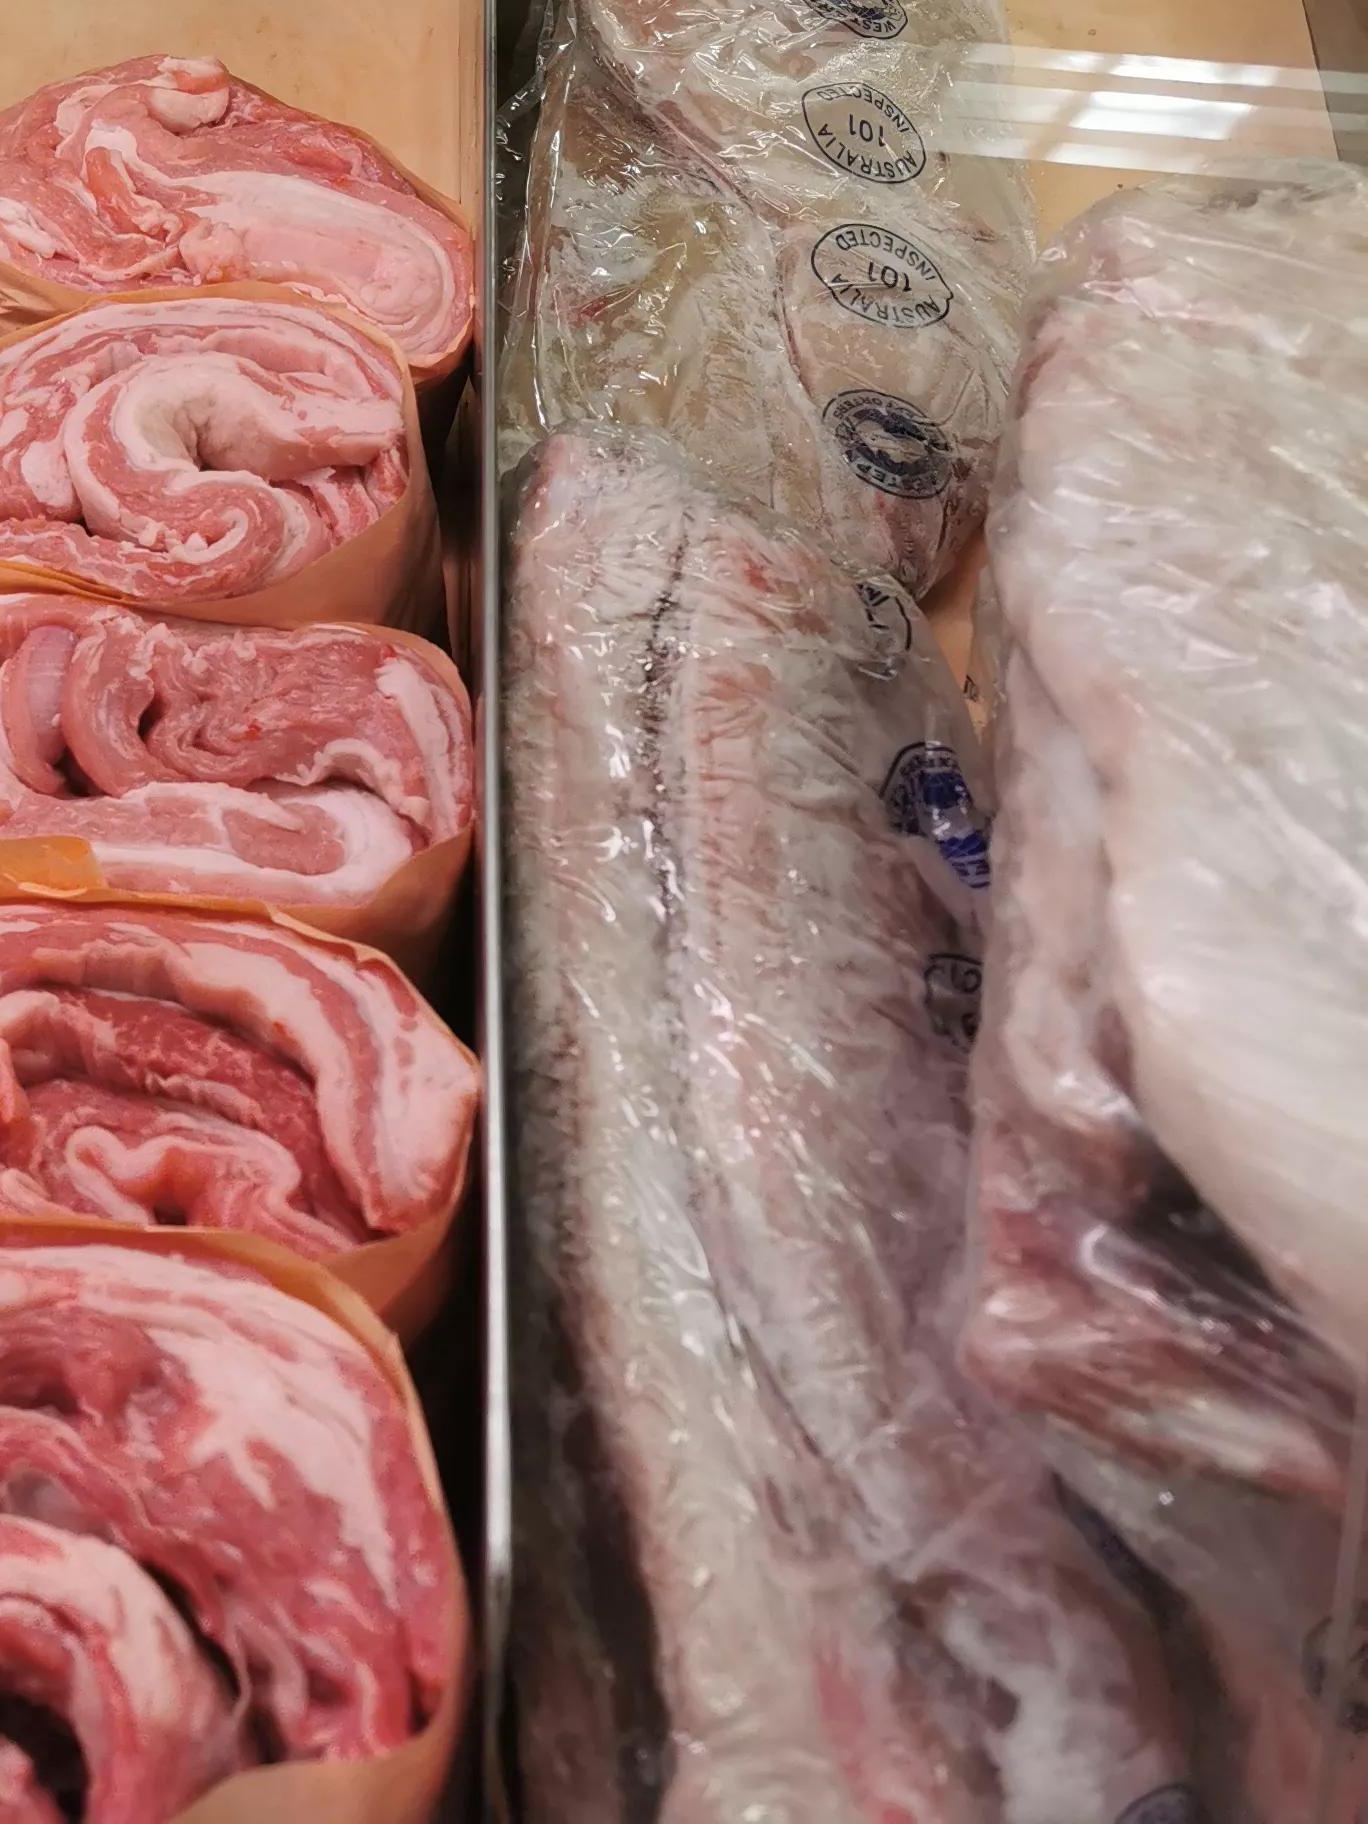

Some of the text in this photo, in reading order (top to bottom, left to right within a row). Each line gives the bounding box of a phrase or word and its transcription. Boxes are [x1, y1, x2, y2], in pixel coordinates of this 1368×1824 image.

[816, 85, 910, 133] INSPECTED
[848, 114, 886, 148] 101
[817, 123, 918, 179] AUSTRALIA
[834, 229, 936, 281] INSPECTED
[867, 262, 912, 293] 101
[831, 273, 941, 323] AUSTRALIA
